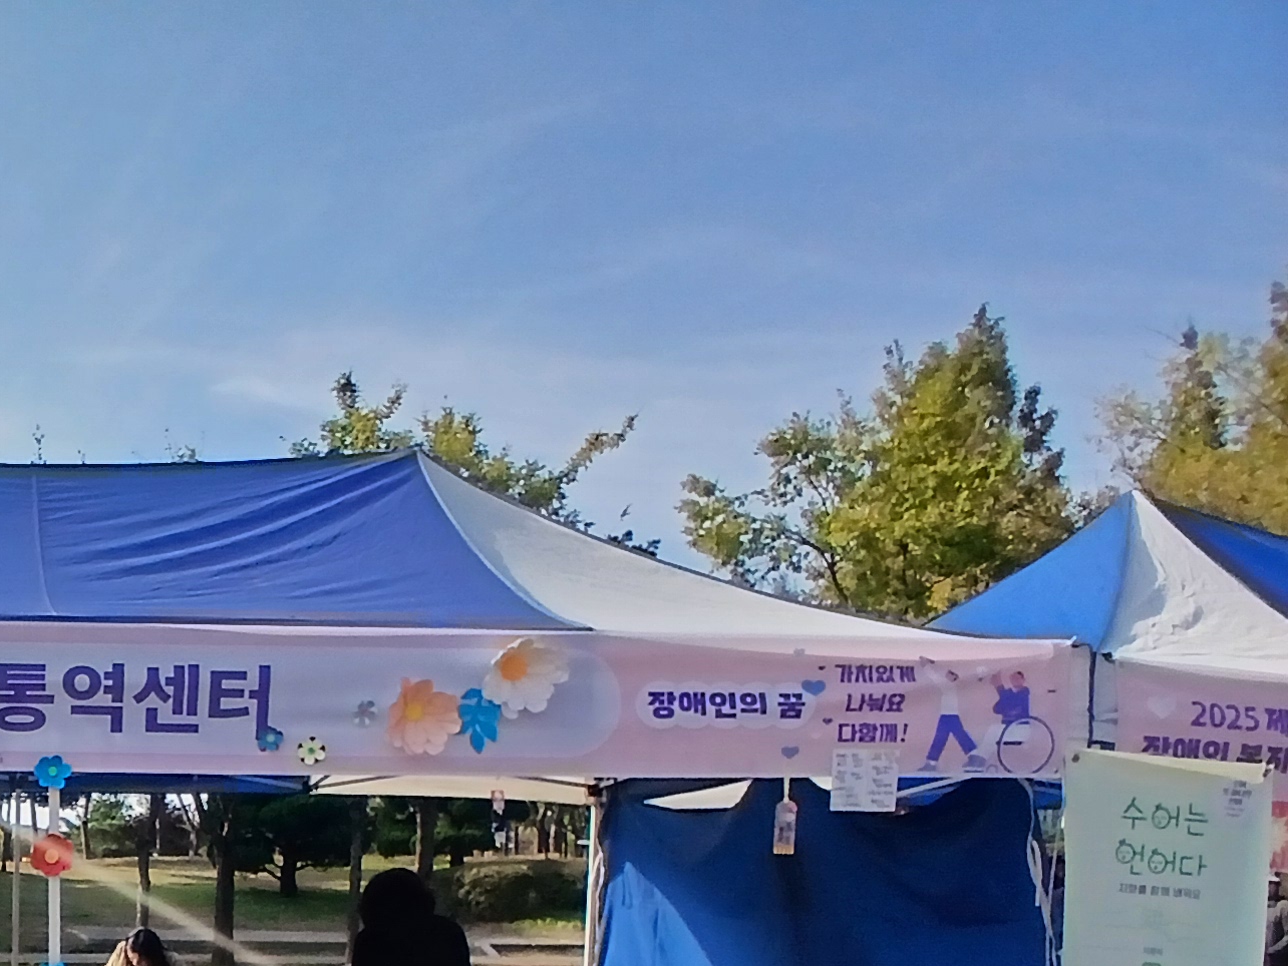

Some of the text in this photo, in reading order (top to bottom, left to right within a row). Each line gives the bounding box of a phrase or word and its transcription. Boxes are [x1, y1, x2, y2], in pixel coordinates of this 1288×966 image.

[835, 664, 916, 683] 가치있게
[648, 691, 806, 719] 장애인의 꿈
[1191, 701, 1260, 731] 2025
[838, 723, 908, 743] 다함께!
[1121, 797, 1209, 836] 수어는
[1115, 838, 1208, 876] 언어다
